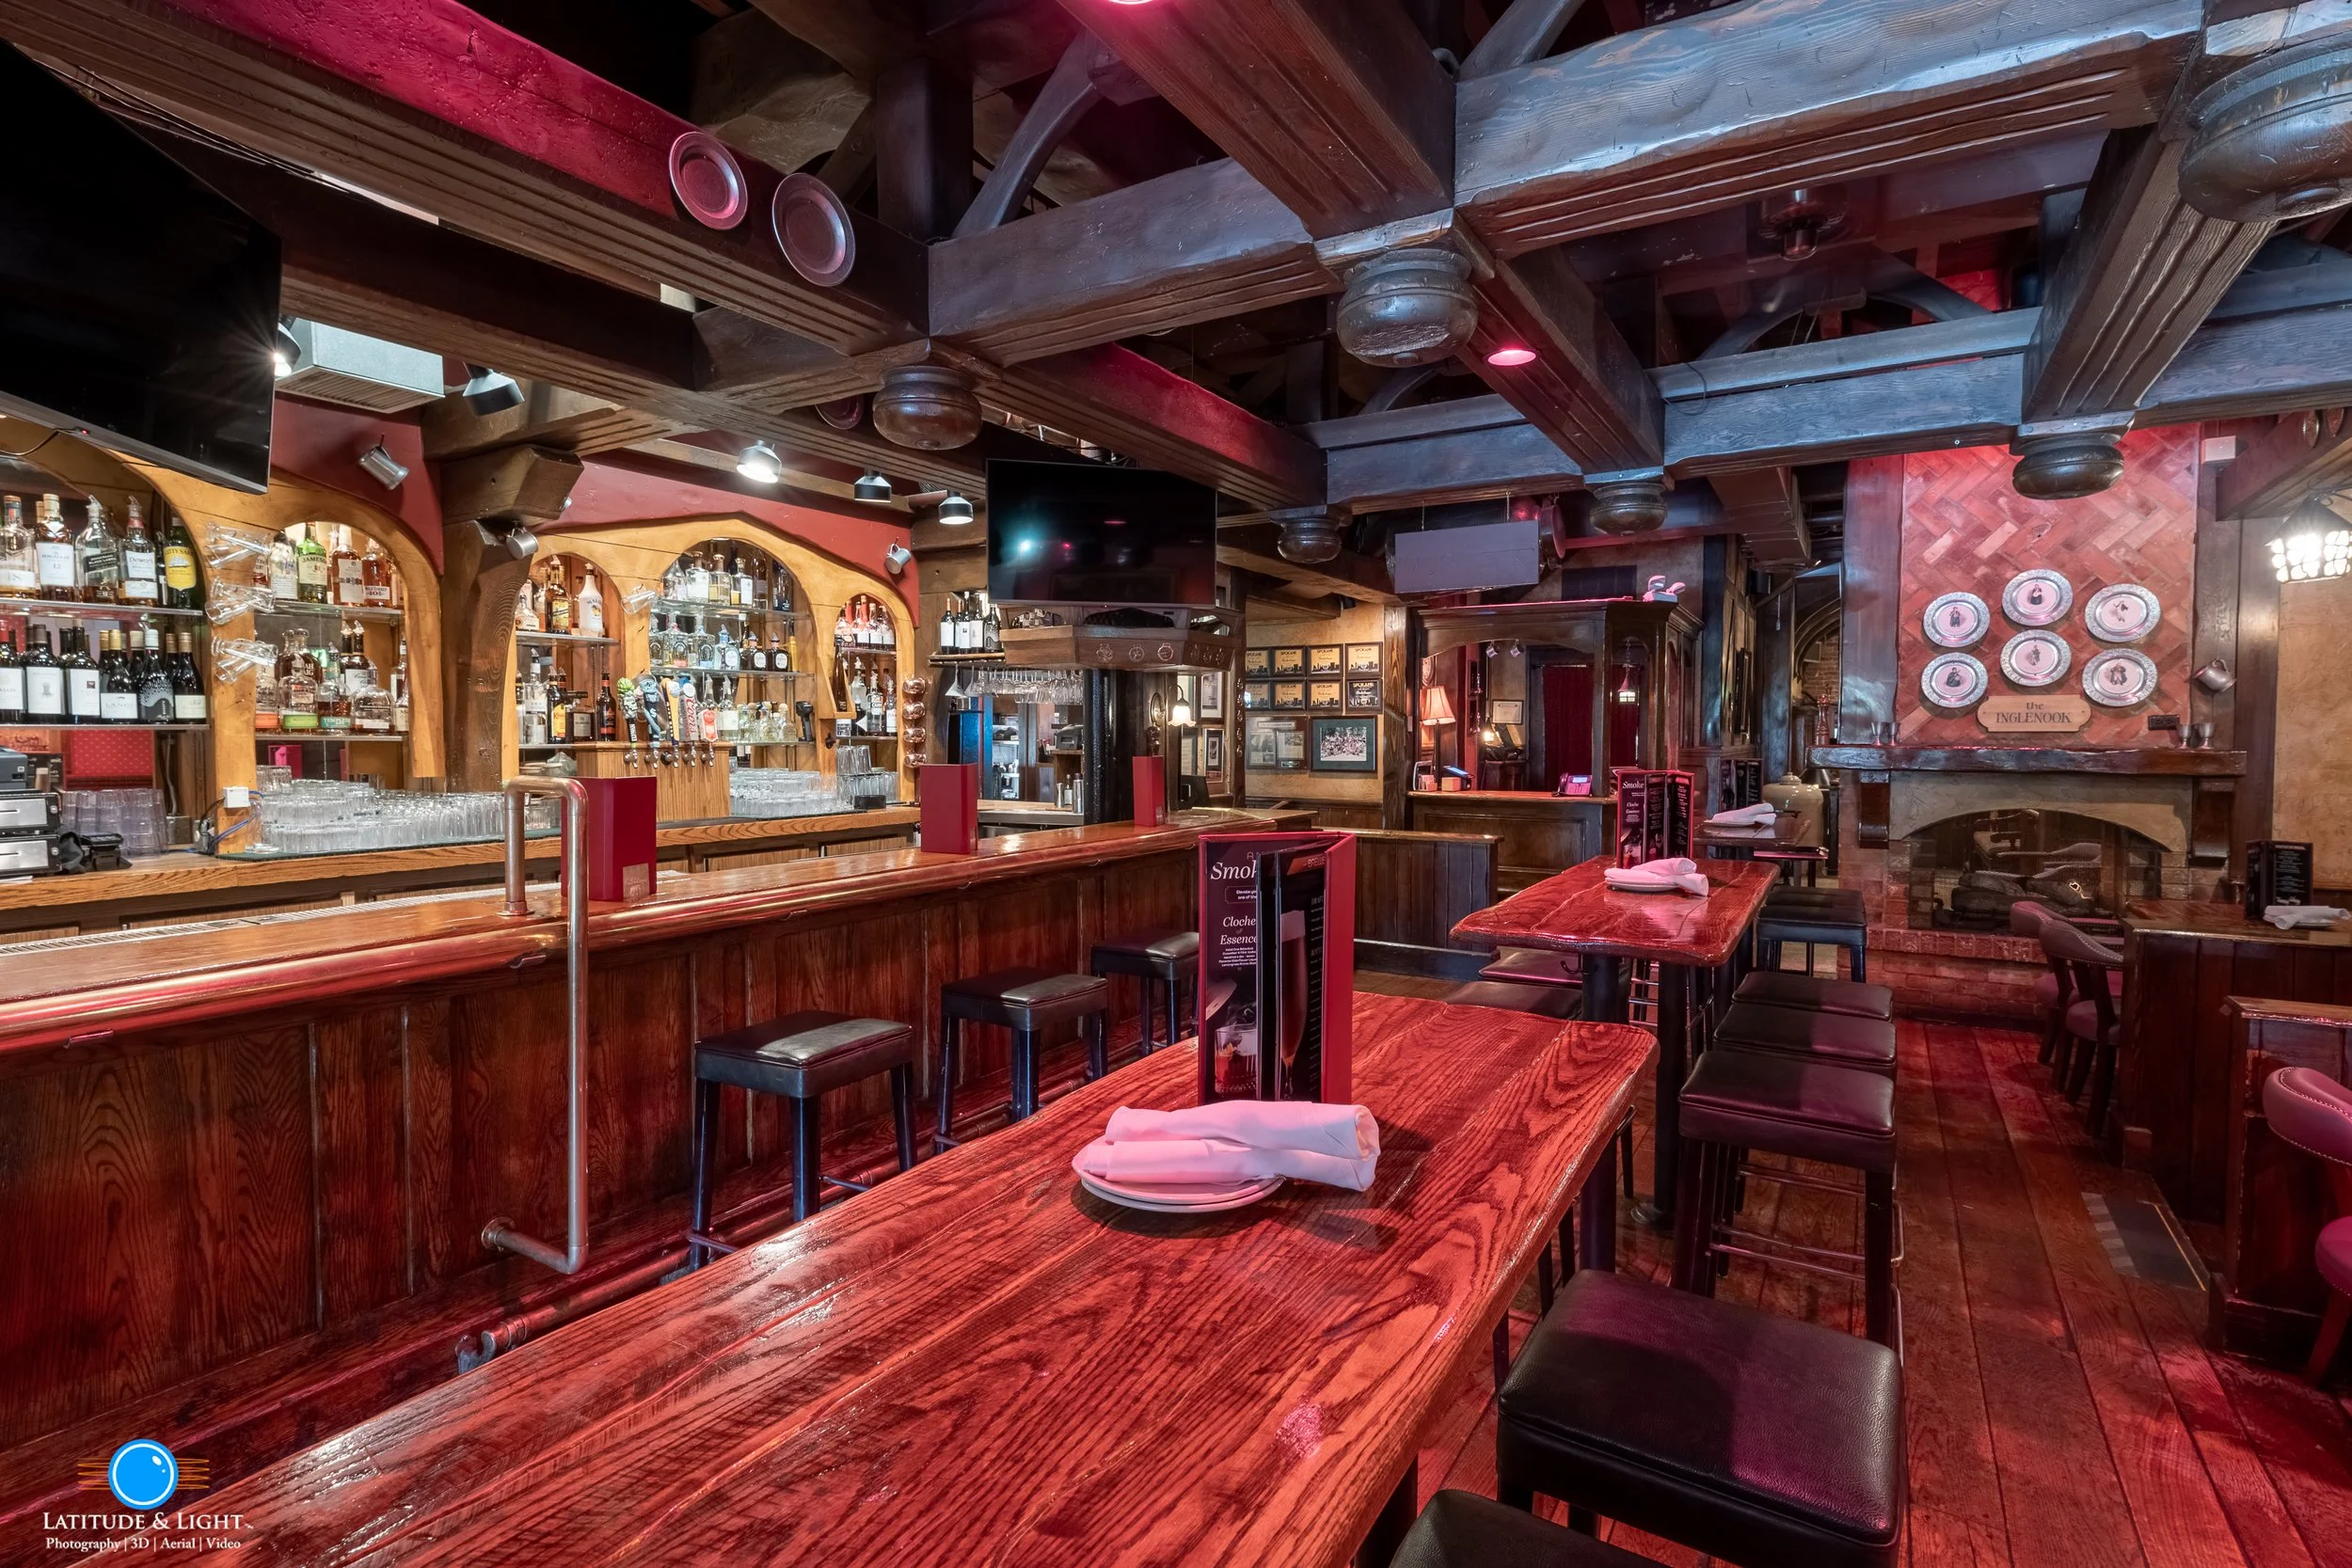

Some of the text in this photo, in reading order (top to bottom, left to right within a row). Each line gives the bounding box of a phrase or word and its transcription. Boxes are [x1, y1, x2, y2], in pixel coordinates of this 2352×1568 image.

[2026, 702, 2044, 710] the
[1995, 712, 2073, 723] INGLENOOK
[1622, 781, 1645, 789] Smoke
[1210, 860, 1257, 880] Smok
[1223, 915, 1257, 927] Cloche
